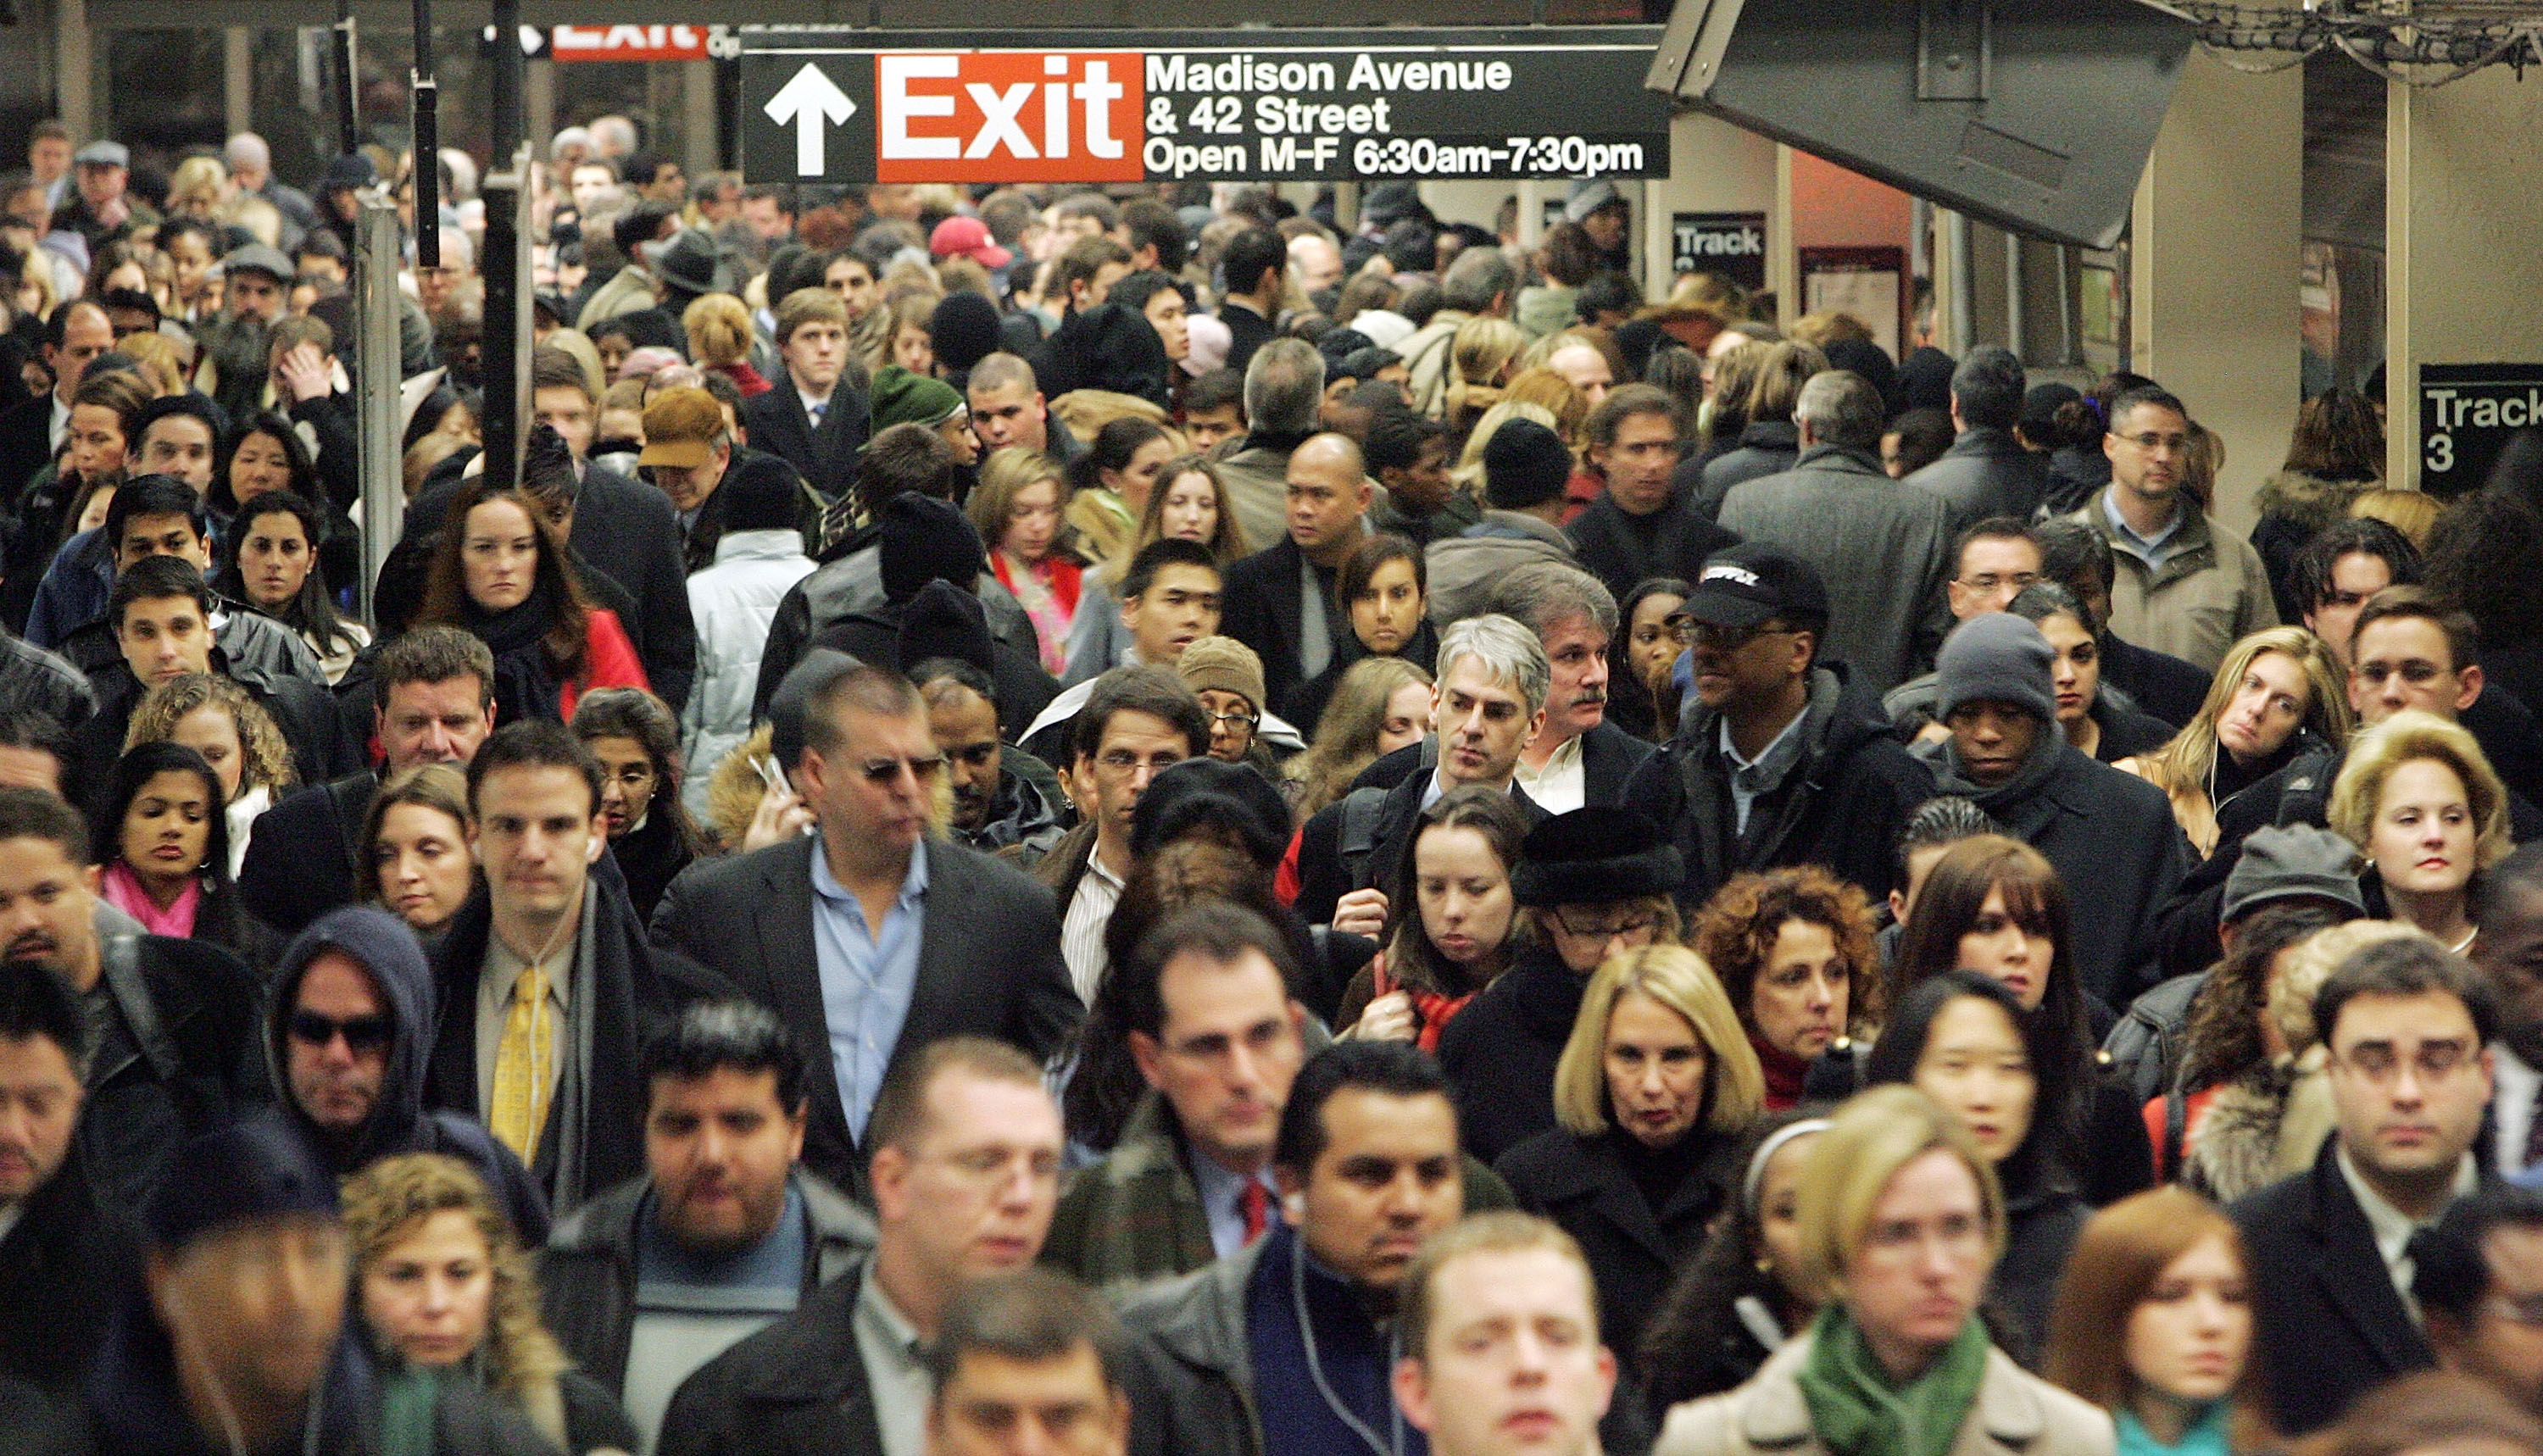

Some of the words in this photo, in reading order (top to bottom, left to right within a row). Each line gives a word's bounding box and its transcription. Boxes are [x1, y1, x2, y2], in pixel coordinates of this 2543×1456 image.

[1145, 54, 1335, 92] Madison
[1346, 53, 1511, 91] Avenue
[881, 56, 1123, 159] Exit
[1145, 97, 1178, 134] &
[1188, 97, 1243, 133] 42
[1255, 96, 1389, 133] Street
[1143, 136, 1246, 178] Open
[1260, 137, 1339, 172] M-F
[1354, 136, 1643, 178] 6:30am-7:30pm
[1675, 226, 1761, 254] Track
[2427, 433, 2454, 472] 3
